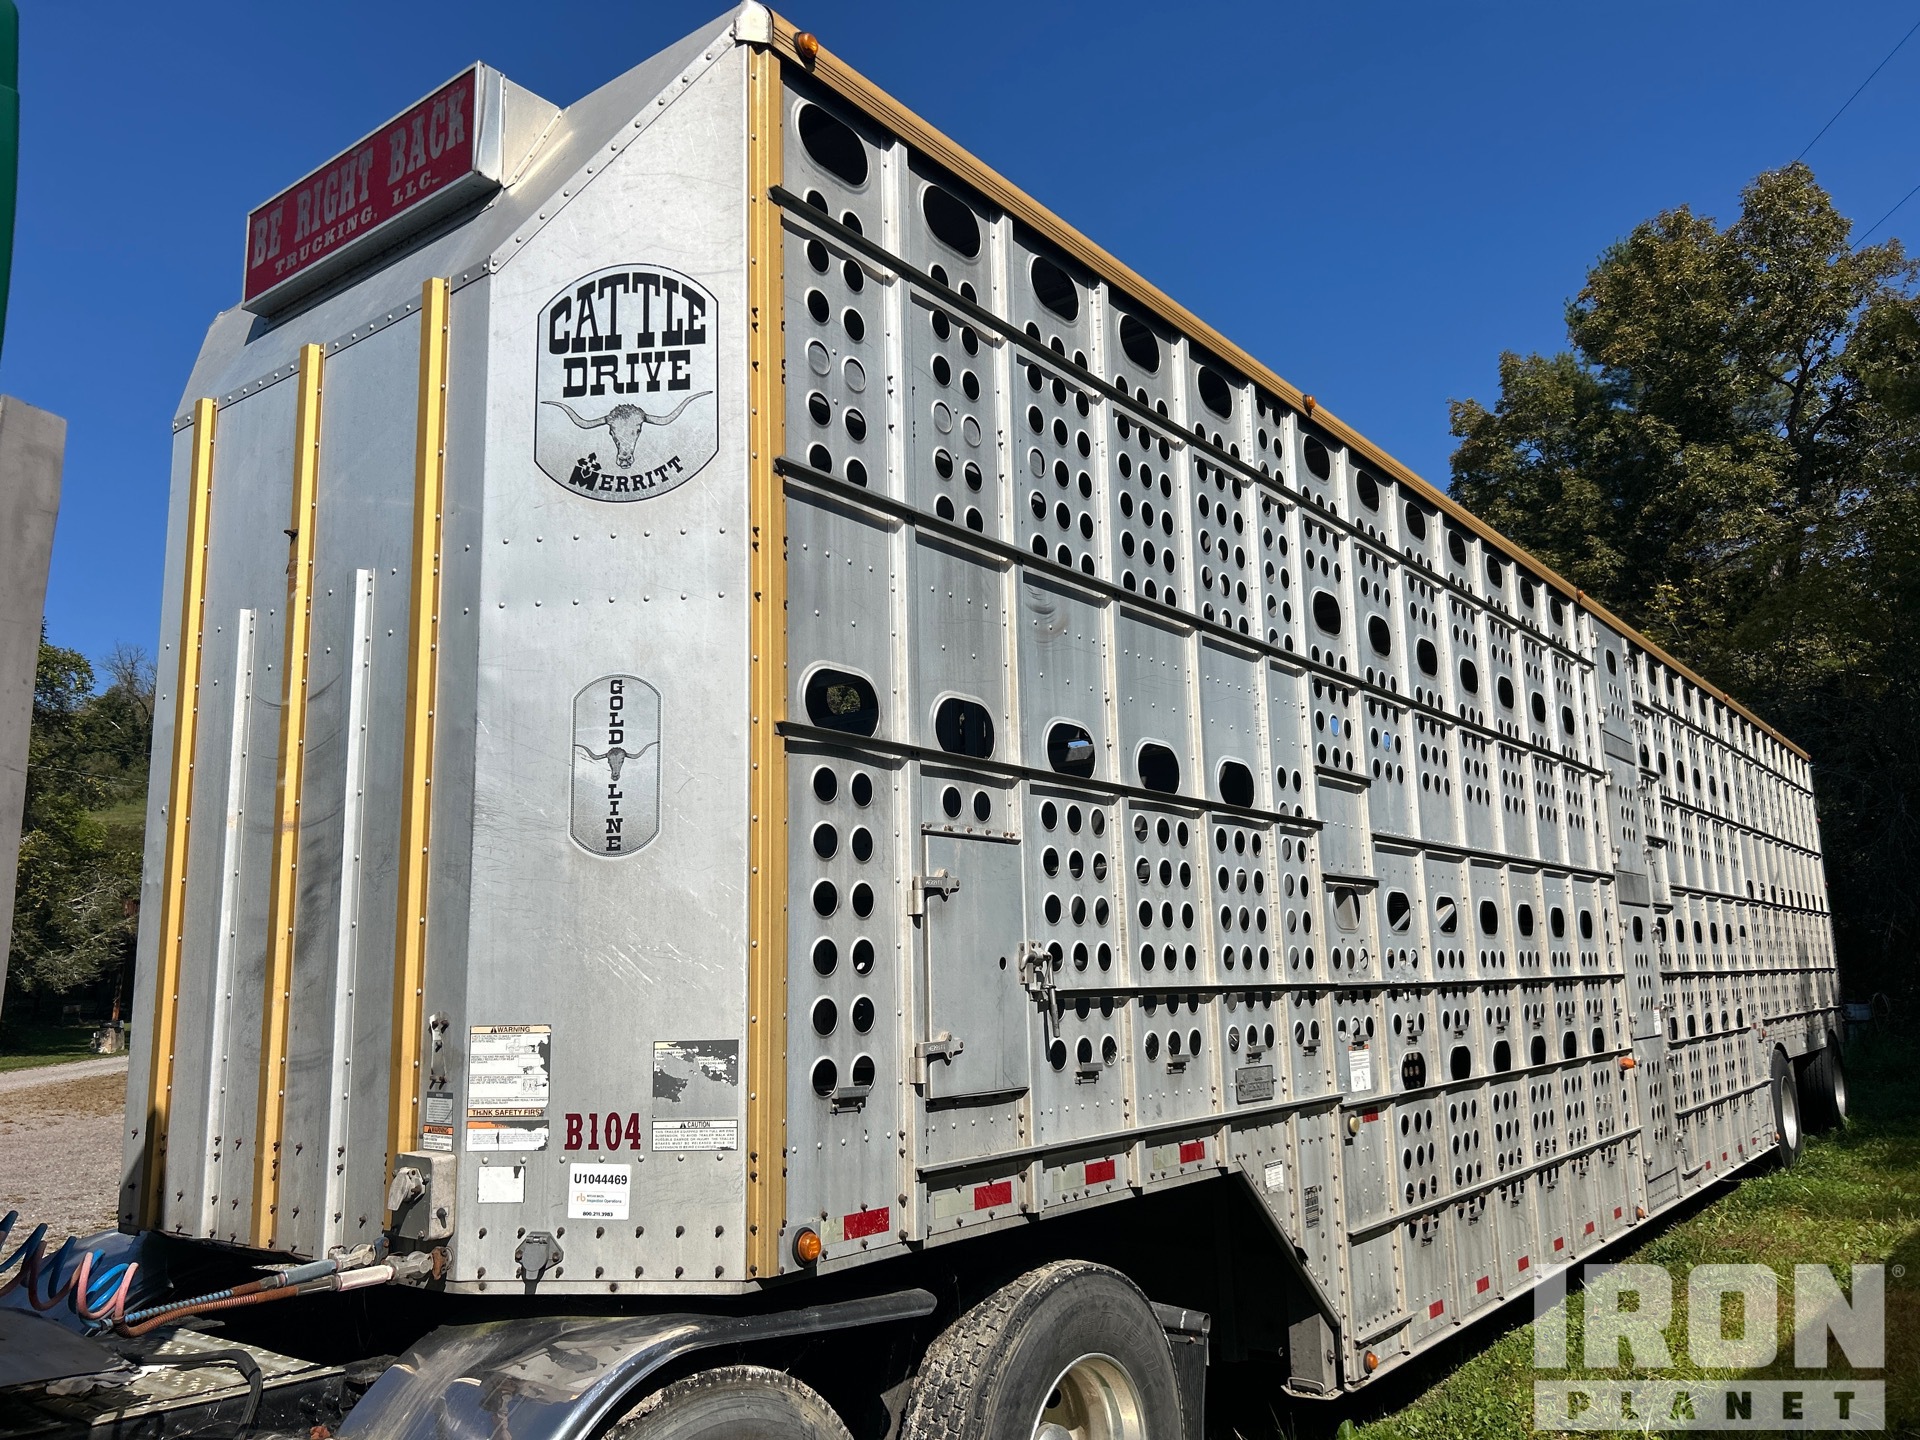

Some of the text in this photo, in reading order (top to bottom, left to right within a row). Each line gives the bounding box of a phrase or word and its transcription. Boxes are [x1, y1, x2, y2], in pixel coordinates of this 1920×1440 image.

[251, 86, 467, 269] BE RIGHT BACK
[549, 272, 706, 355] CATTLE
[563, 350, 691, 398] DRIVE
[568, 455, 684, 492] MERRITT
[609, 679, 625, 745] GOLD
[606, 784, 623, 851] LINE
[564, 1112, 641, 1151] B104
[574, 1173, 628, 1185] U1044469
